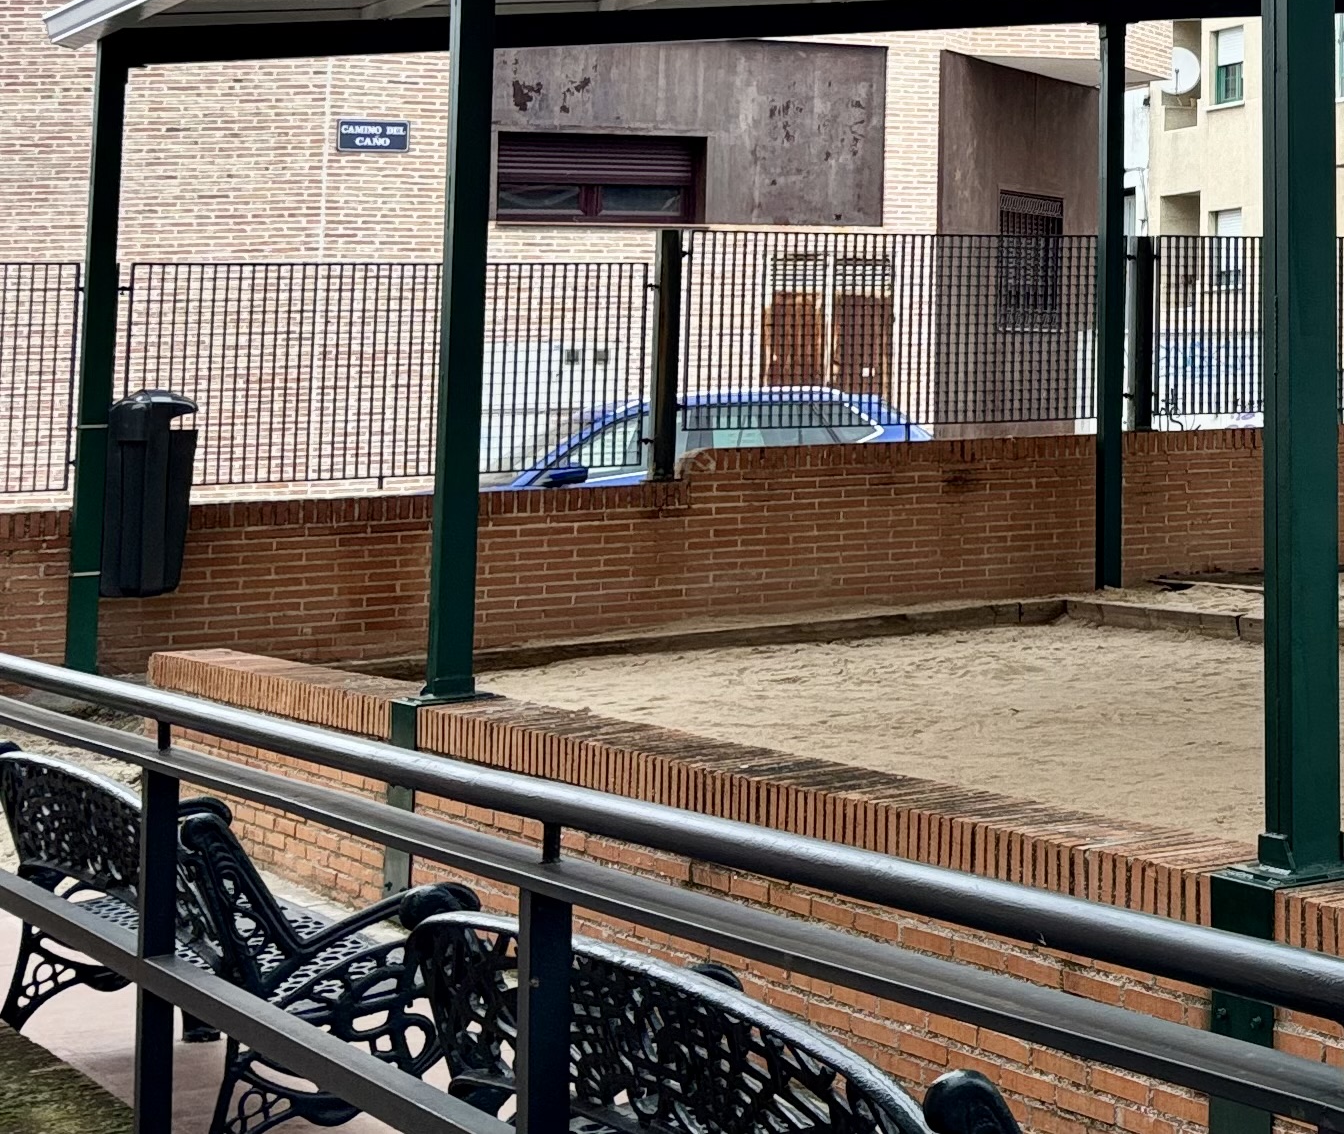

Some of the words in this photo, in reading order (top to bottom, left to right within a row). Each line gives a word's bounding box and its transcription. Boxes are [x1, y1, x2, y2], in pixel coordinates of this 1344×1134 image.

[341, 125, 382, 134] CAMINO
[386, 126, 406, 135] DEL
[354, 135, 390, 146] CAÑO
